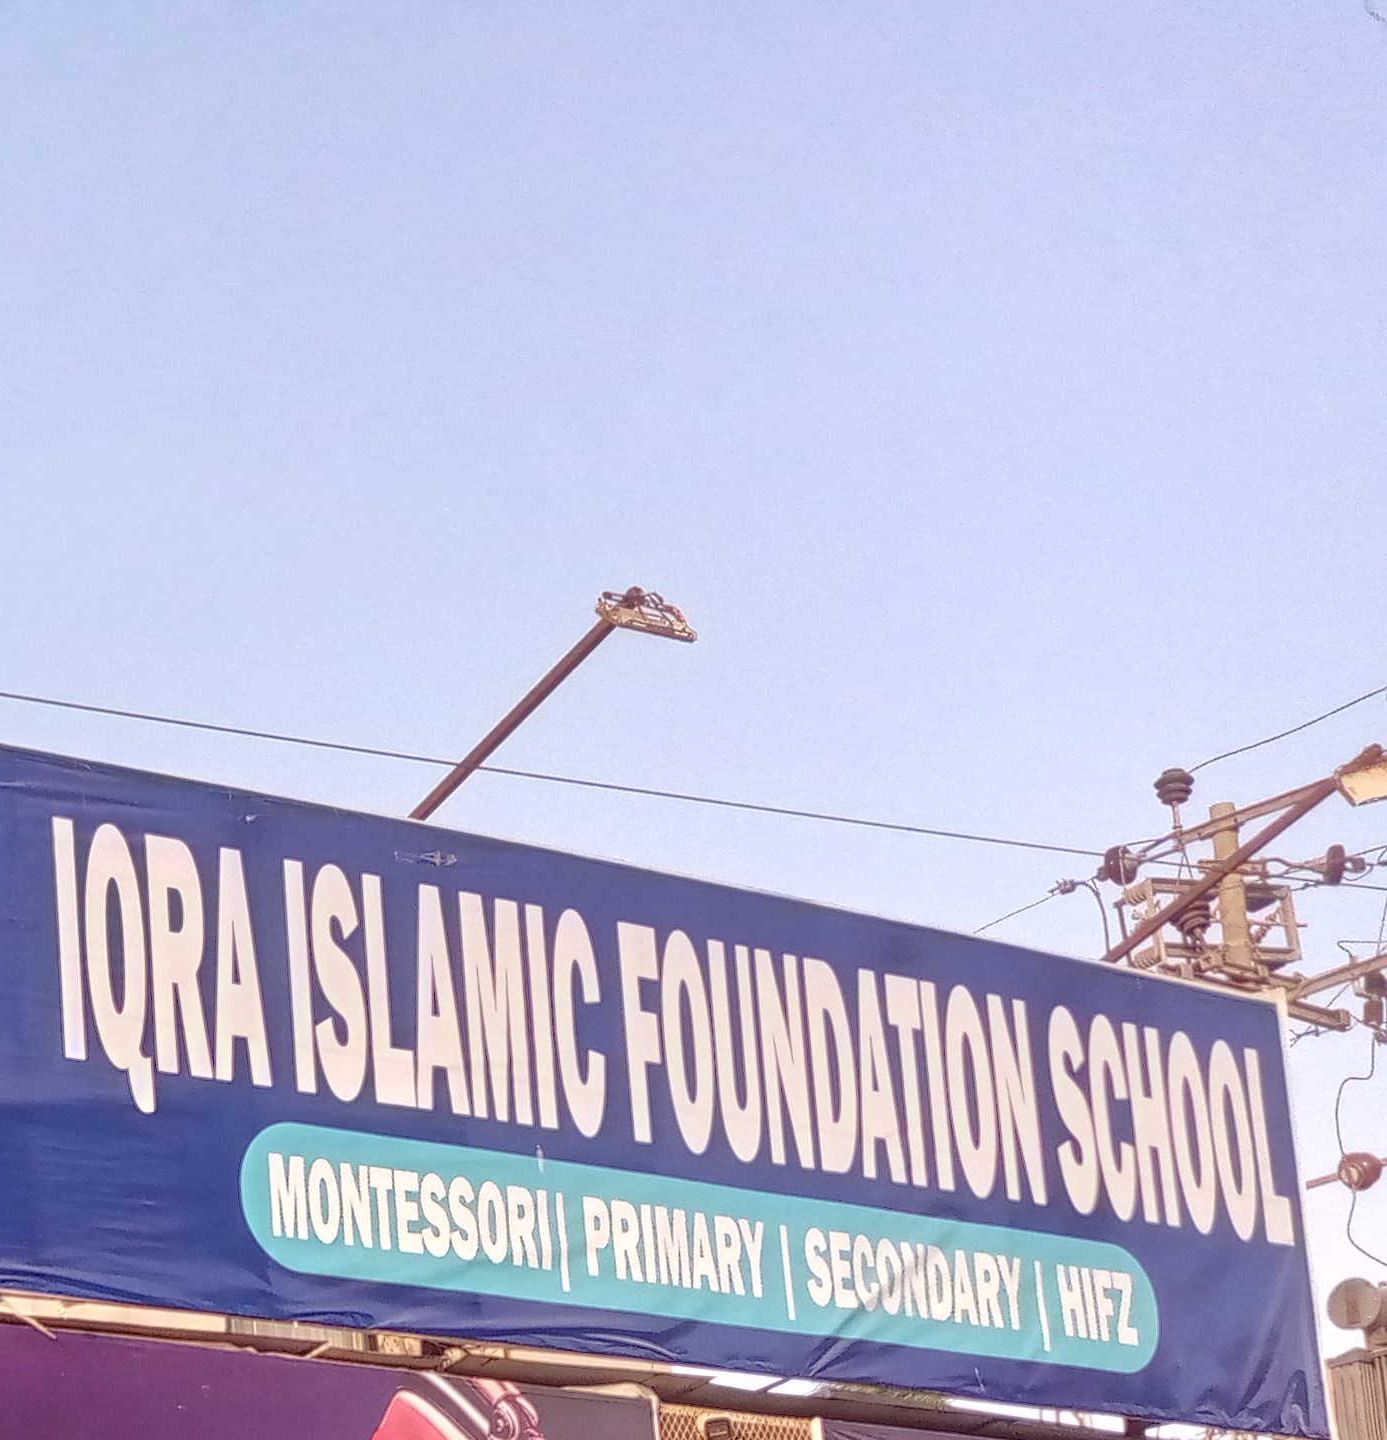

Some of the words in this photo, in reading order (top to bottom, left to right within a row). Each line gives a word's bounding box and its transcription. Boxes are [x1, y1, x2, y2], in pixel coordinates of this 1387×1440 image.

[51, 816, 273, 1113] IQRA
[282, 858, 606, 1138] ISLAMIC
[618, 921, 1047, 1204] FOUNDATION
[1048, 1003, 1295, 1246] SCHOOL
[583, 1196, 764, 1298] PRIMARY
[804, 1227, 1021, 1330] SECONDARY
[1056, 1264, 1140, 1346] HIFZ
